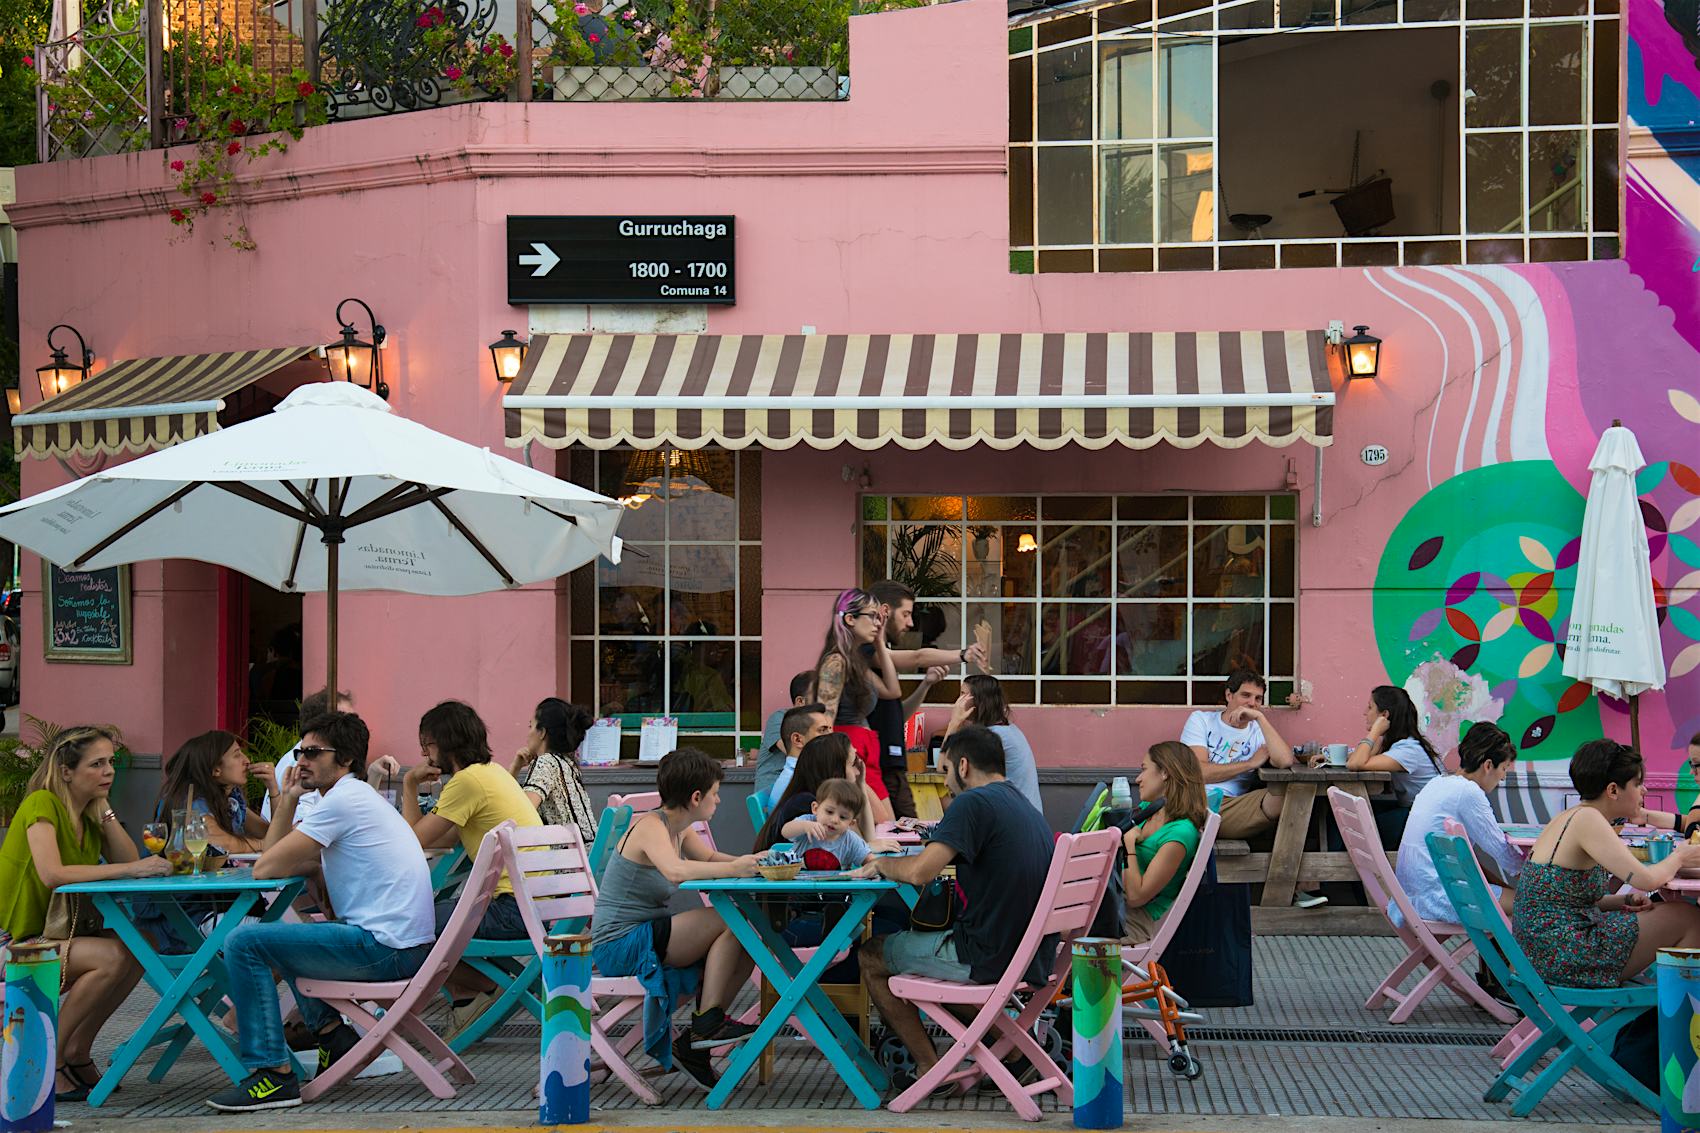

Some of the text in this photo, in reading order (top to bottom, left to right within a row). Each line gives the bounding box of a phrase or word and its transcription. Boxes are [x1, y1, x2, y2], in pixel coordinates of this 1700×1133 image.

[619, 220, 727, 239] Gurruchaga
[629, 262, 669, 278] 1800
[687, 262, 727, 278] 1700
[660, 285, 727, 296] Comuna 14
[1365, 449, 1385, 461] 1795
